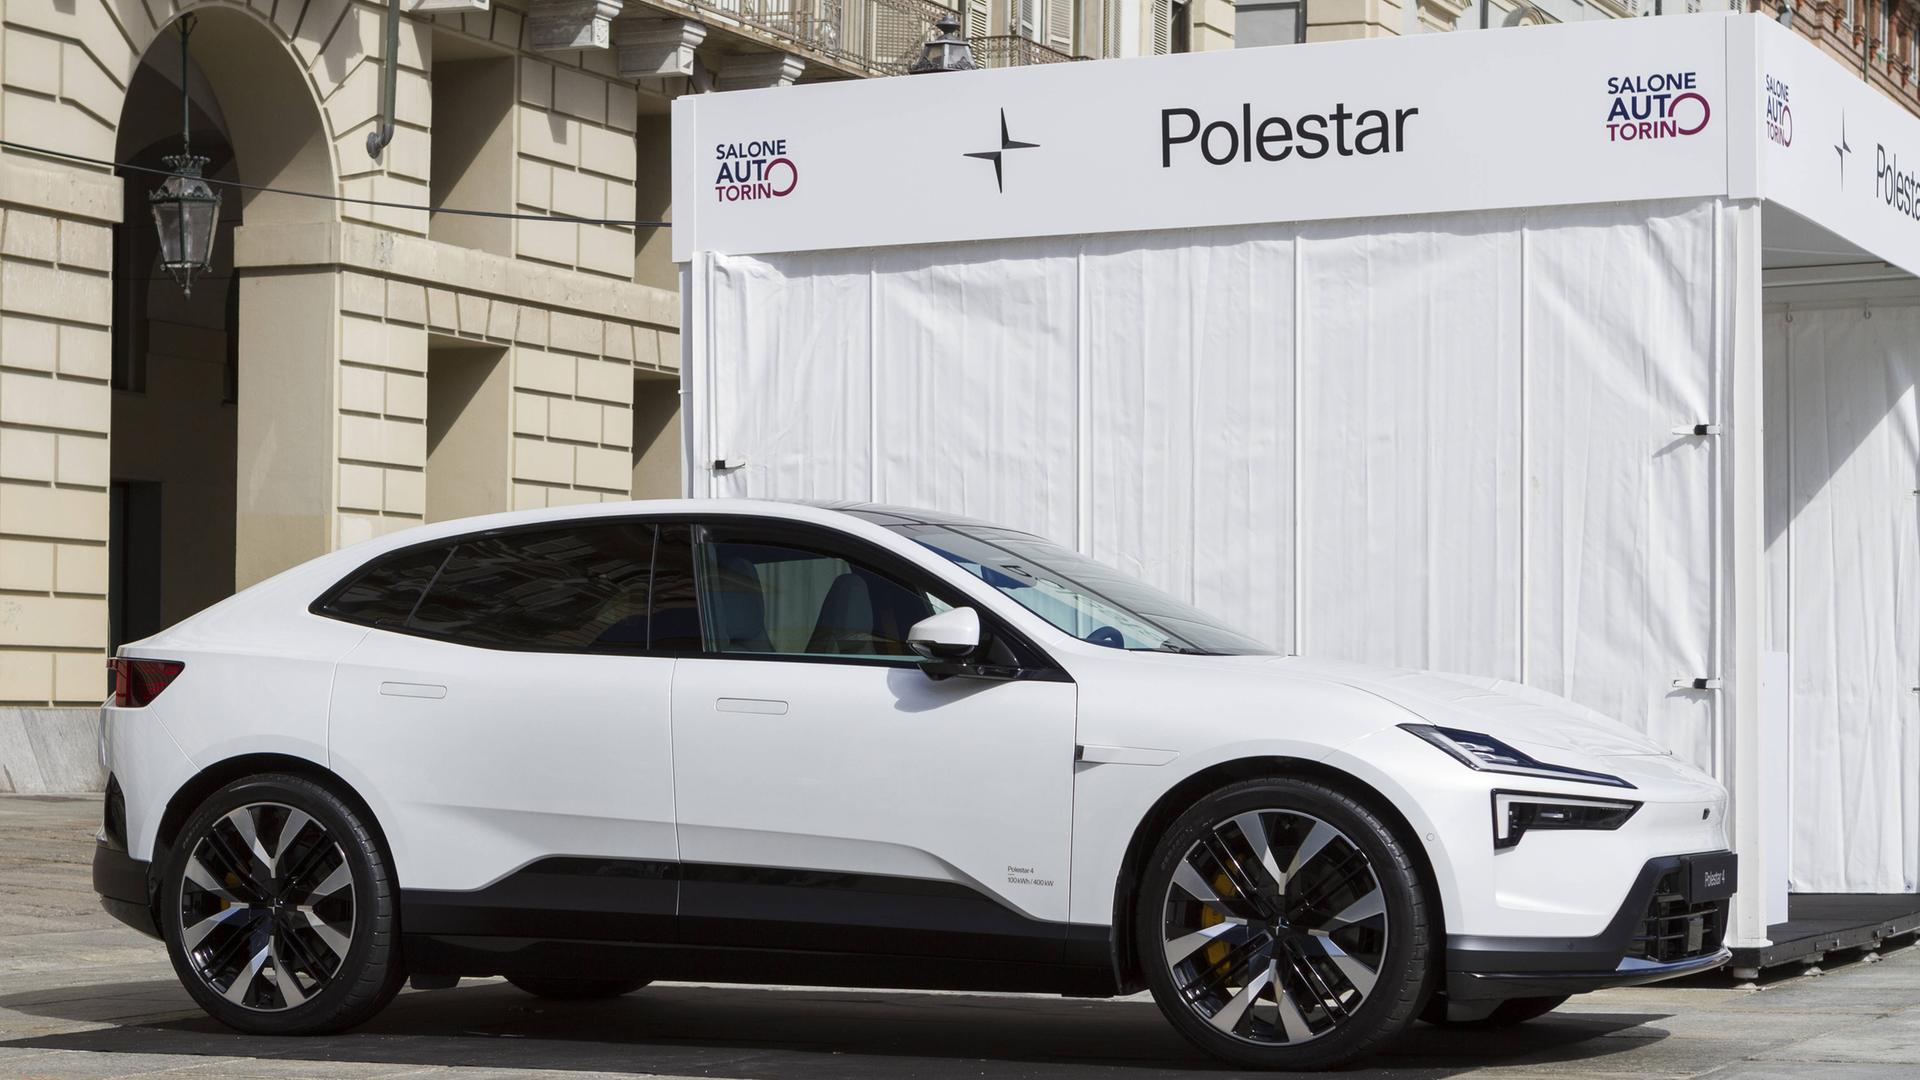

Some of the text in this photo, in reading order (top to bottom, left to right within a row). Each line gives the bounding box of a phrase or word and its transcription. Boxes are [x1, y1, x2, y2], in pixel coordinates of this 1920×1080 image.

[1606, 72, 1696, 94] SALONE
[1766, 74, 1789, 102] SALONE
[1607, 93, 1710, 135] AUTO
[1766, 95, 1792, 147] AUTO
[716, 139, 786, 159] SALONE
[1161, 103, 1418, 167] Polestar
[716, 158, 798, 197] AUTO
[1008, 865, 1029, 873] Polestar
[1705, 868, 1726, 888] Polestar 4
